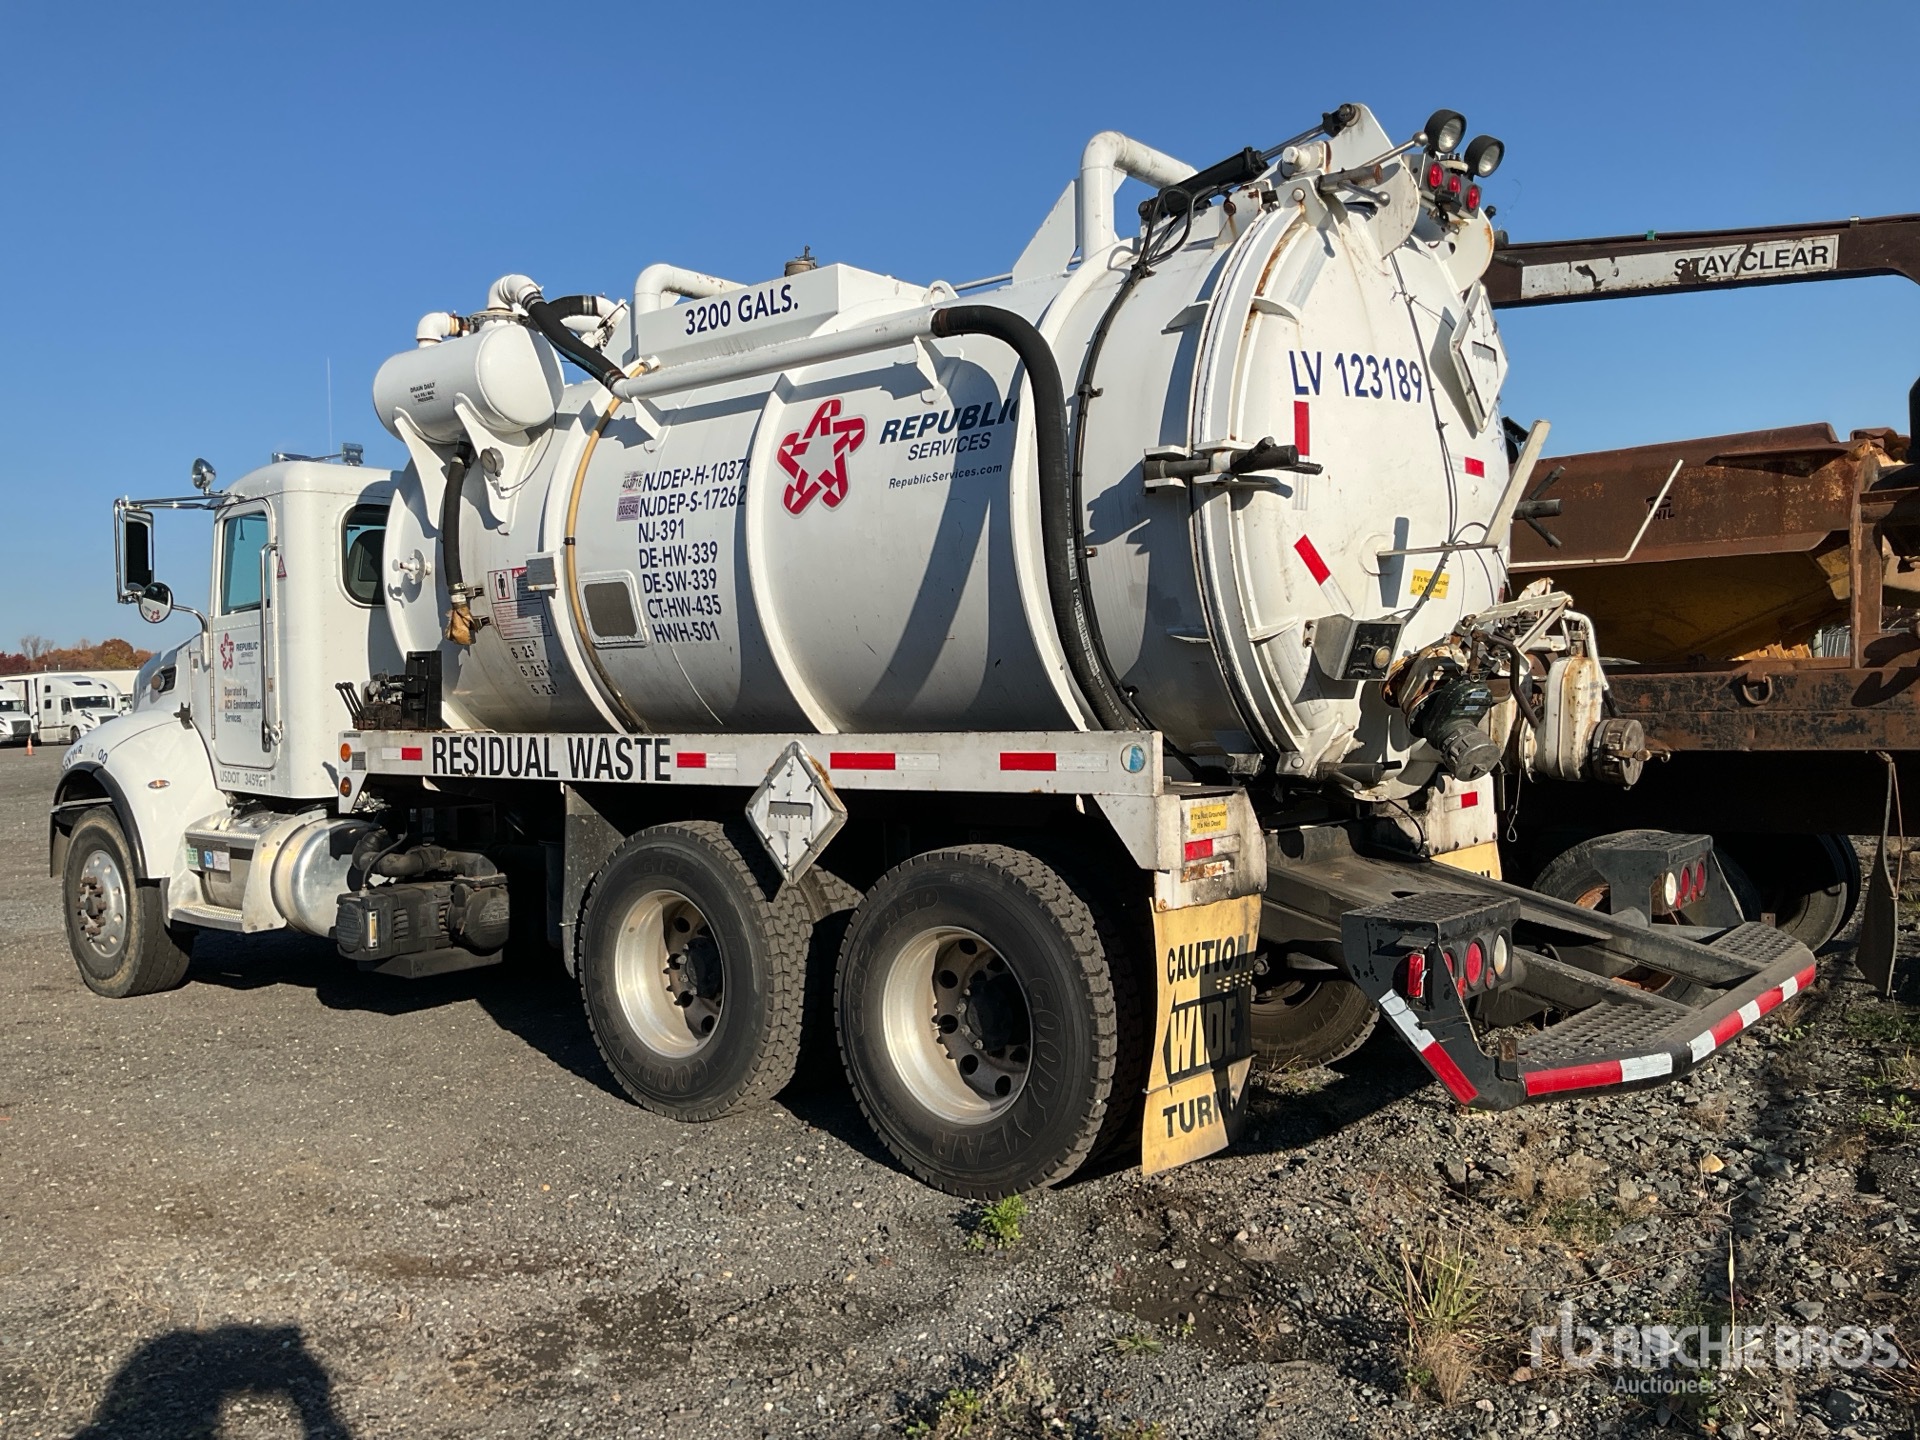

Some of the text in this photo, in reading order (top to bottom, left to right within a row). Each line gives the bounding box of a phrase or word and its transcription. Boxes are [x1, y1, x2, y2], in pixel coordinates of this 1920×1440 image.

[1741, 245, 1828, 271] CLEAR
[685, 284, 799, 335] 3200 GALS.
[1289, 350, 1422, 403] LV 123189
[907, 431, 992, 461] SERVICES
[888, 464, 1003, 489] RepublicServices.com
[640, 485, 747, 518] NJDEP-S-17262
[638, 518, 684, 543] NJ-391
[639, 541, 718, 569] DE-HW-339
[642, 568, 717, 593] DE-SW-339
[647, 594, 722, 619] CT-HW-435
[652, 621, 720, 643] HWH-501
[236, 641, 259, 651] REPUBLIC
[224, 713, 241, 722] Services
[233, 699, 262, 710] Environmental
[432, 736, 671, 781] RESIDUAL WASTE
[220, 771, 240, 784] USDOT
[1167, 932, 1250, 986] CAUTION
[1170, 999, 1237, 1076] WIDE
[932, 976, 1063, 1166] GOODYEAR
[1162, 1088, 1233, 1139] TURN
